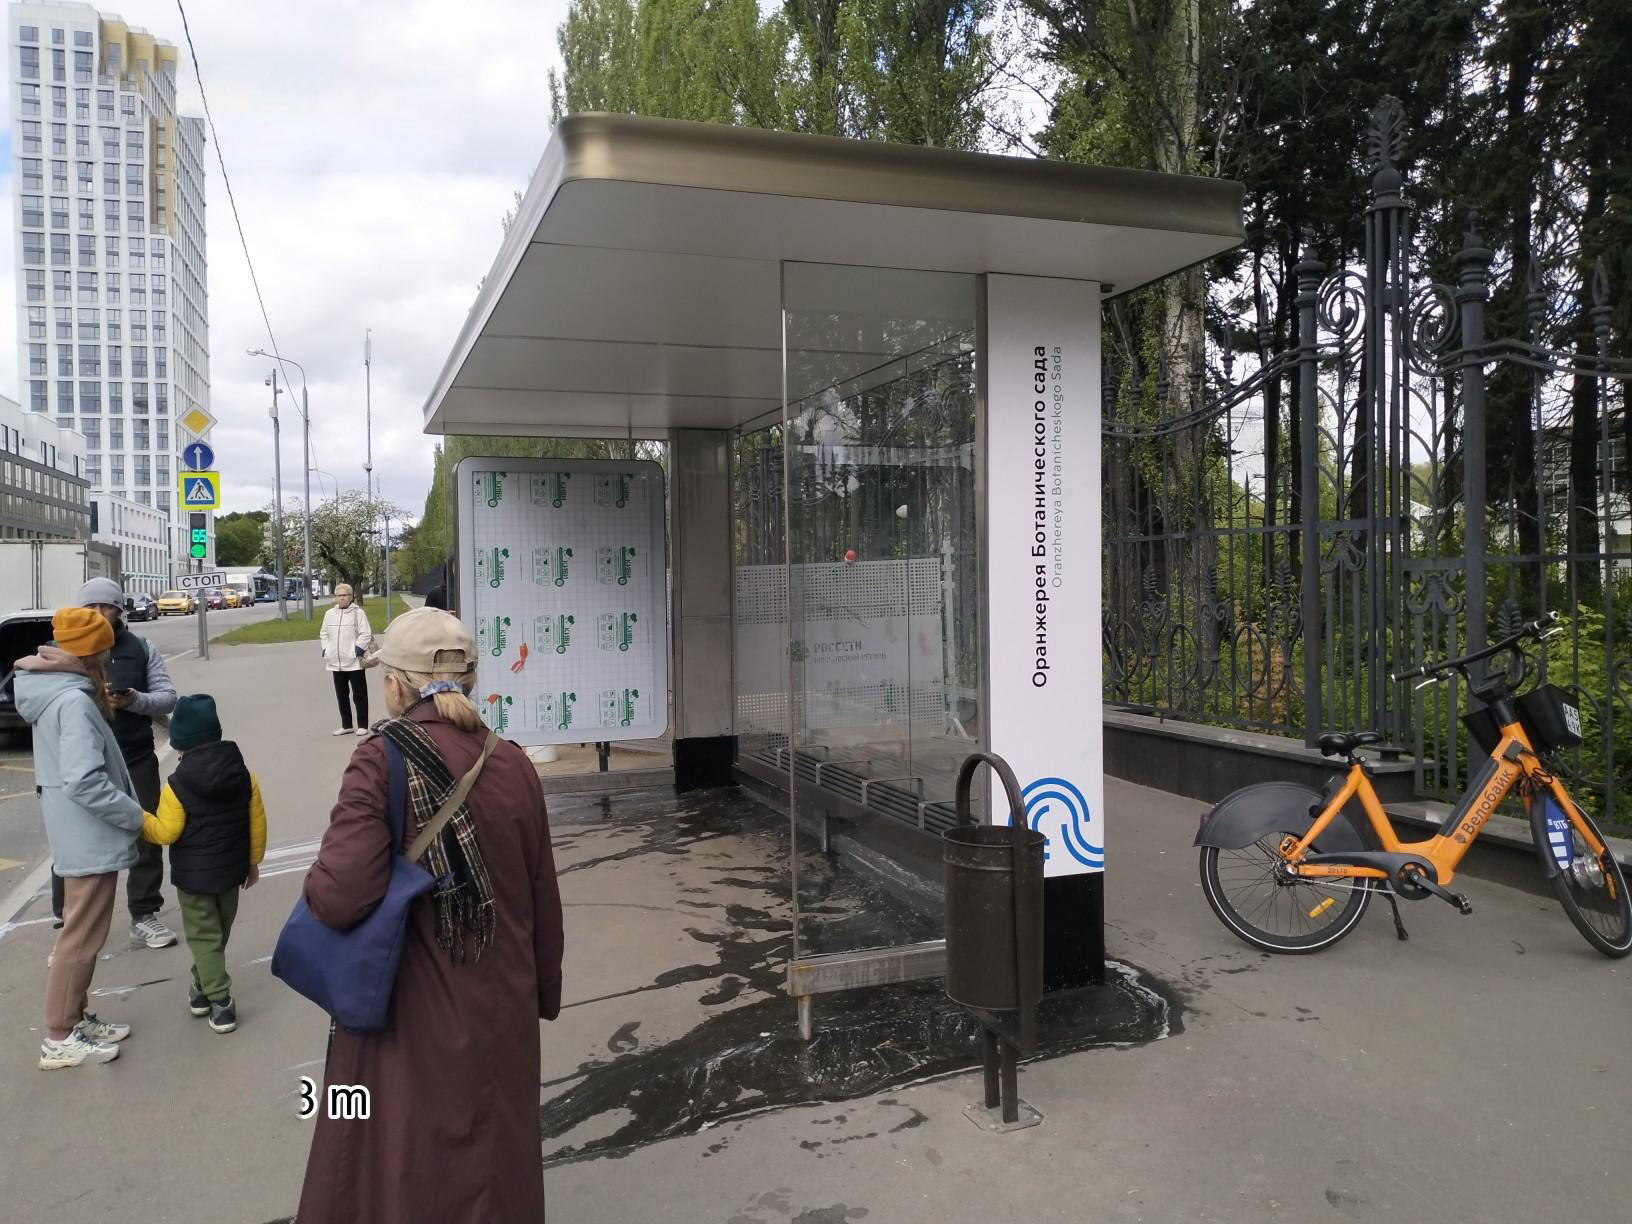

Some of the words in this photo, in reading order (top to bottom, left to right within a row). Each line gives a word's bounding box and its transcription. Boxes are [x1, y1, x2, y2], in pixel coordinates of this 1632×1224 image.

[1034, 346, 1048, 394] сада
[1051, 346, 1062, 380] Sada
[1051, 385, 1063, 496] Botanicheskogo
[1031, 400, 1046, 557] Ботанического
[192, 529, 207, 543] 65
[1051, 500, 1063, 588] Oranzhereya
[182, 575, 221, 588] СТОП
[1032, 565, 1050, 688] Оранжерея
[1461, 768, 1513, 835] Велобайк
